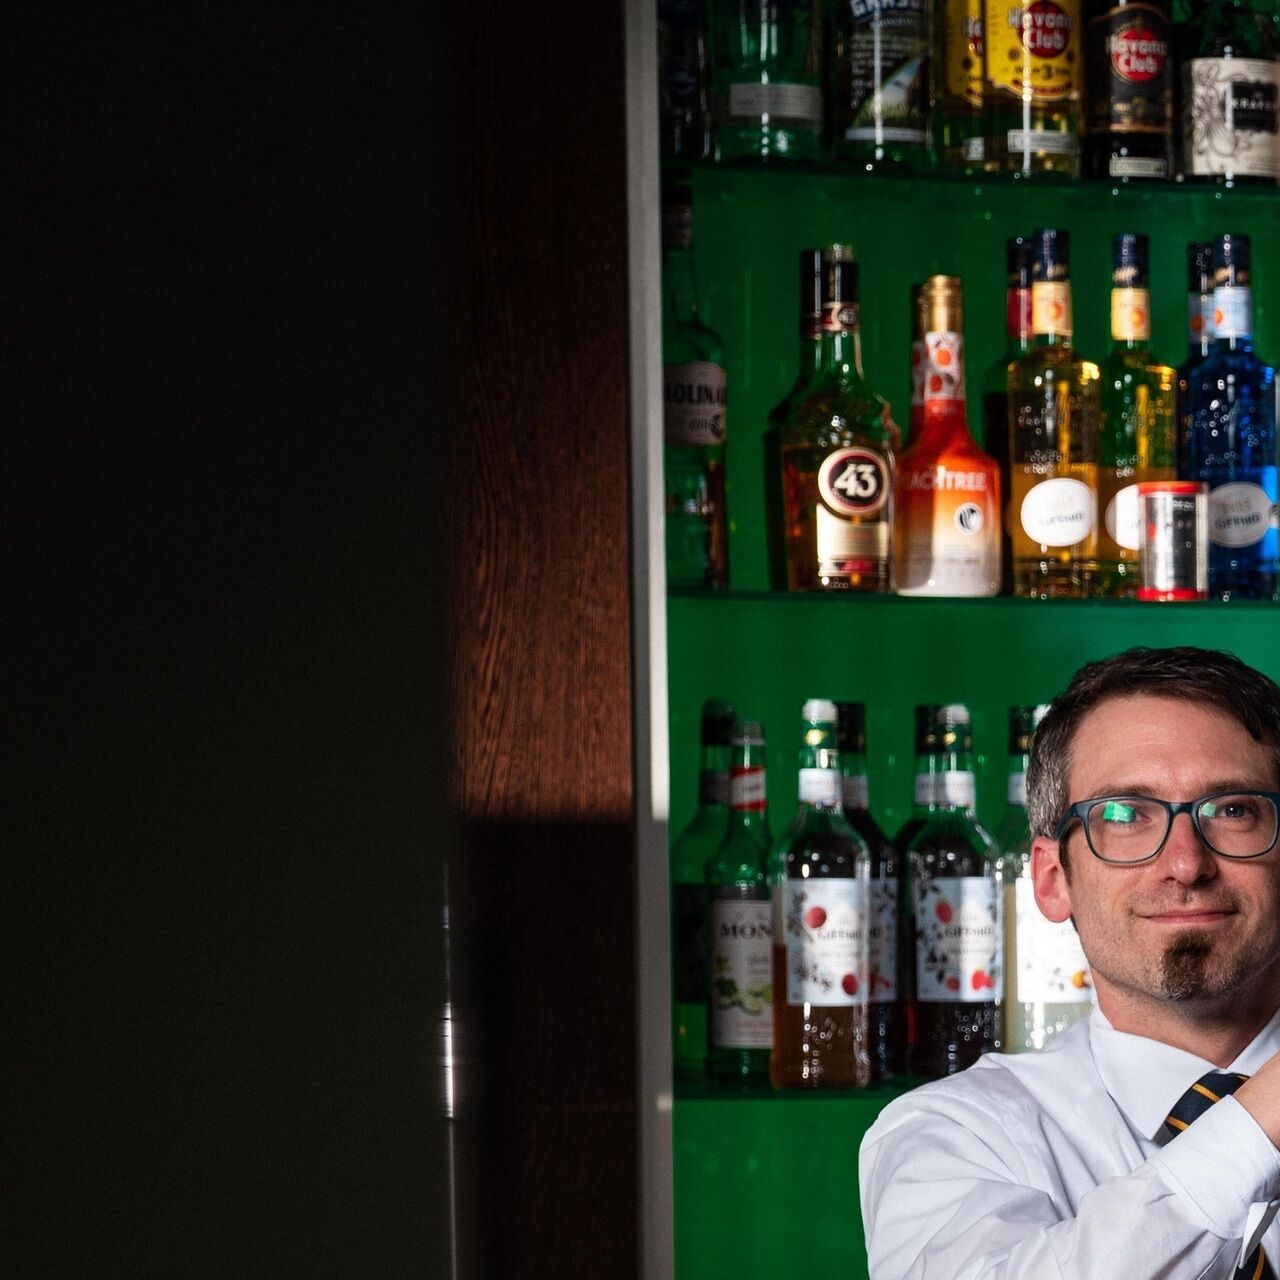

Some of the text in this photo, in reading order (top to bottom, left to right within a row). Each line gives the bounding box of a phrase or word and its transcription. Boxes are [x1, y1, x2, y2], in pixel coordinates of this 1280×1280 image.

[1008, 8, 1074, 29] Havana
[1022, 27, 1066, 49] Club
[1105, 34, 1168, 56] Havana
[1119, 53, 1158, 73] Club
[833, 462, 878, 499] 43
